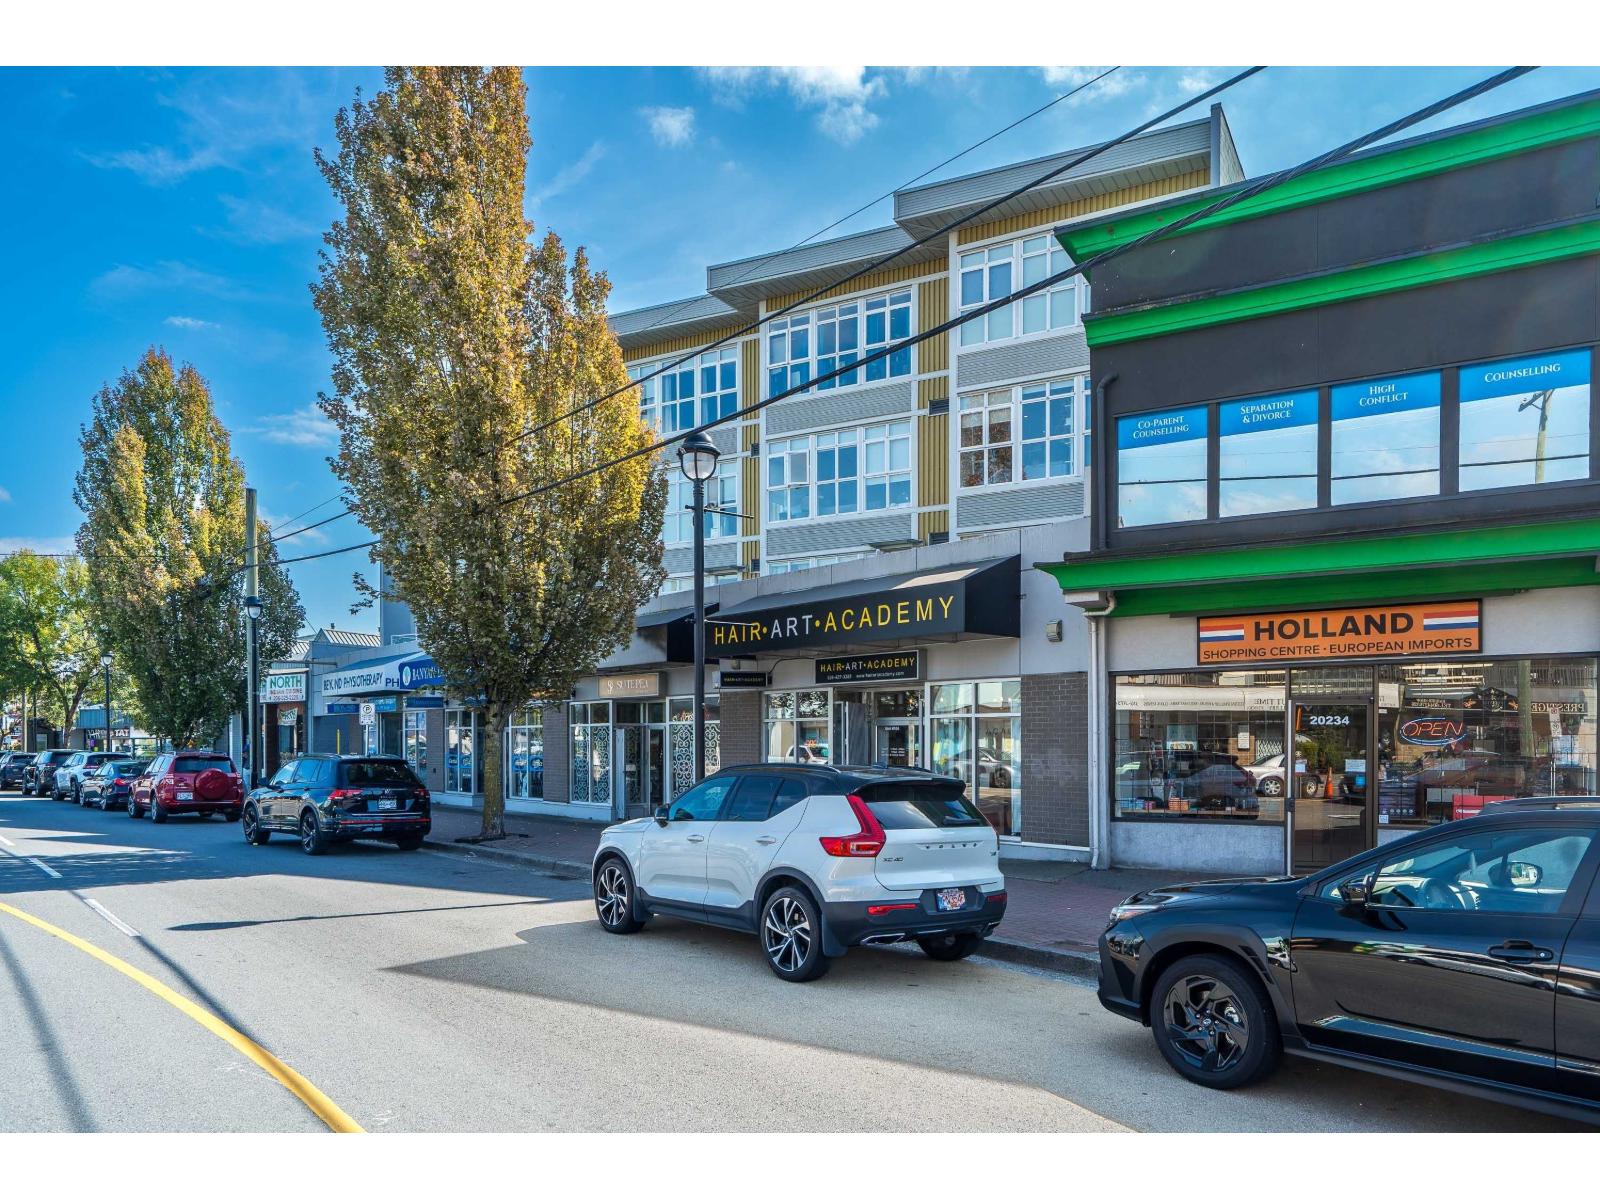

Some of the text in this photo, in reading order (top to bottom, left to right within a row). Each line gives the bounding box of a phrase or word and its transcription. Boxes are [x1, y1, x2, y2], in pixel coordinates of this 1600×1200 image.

[1484, 363, 1561, 383] COUNSELLING
[1369, 384, 1395, 395] HIGH
[1240, 399, 1294, 415] SEPARATION
[1359, 392, 1408, 407] CONFLICT
[1137, 415, 1185, 430] CO-PARENT
[1242, 410, 1291, 424] & DIVORCE
[1133, 424, 1190, 439] COUNSELLING
[770, 614, 813, 640] ART
[824, 595, 954, 633] ACADEMY
[1254, 612, 1414, 641] HOLLAND
[1203, 637, 1473, 660] SHOPPING CENTRE EUROPEAN IMPORTS
[867, 657, 915, 669] ACADEMY
[270, 675, 302, 689] NORTH
[343, 672, 383, 688] PHYSIOTHERAPY
[1310, 715, 1350, 726] 20234
[1402, 721, 1464, 737] OPEN
